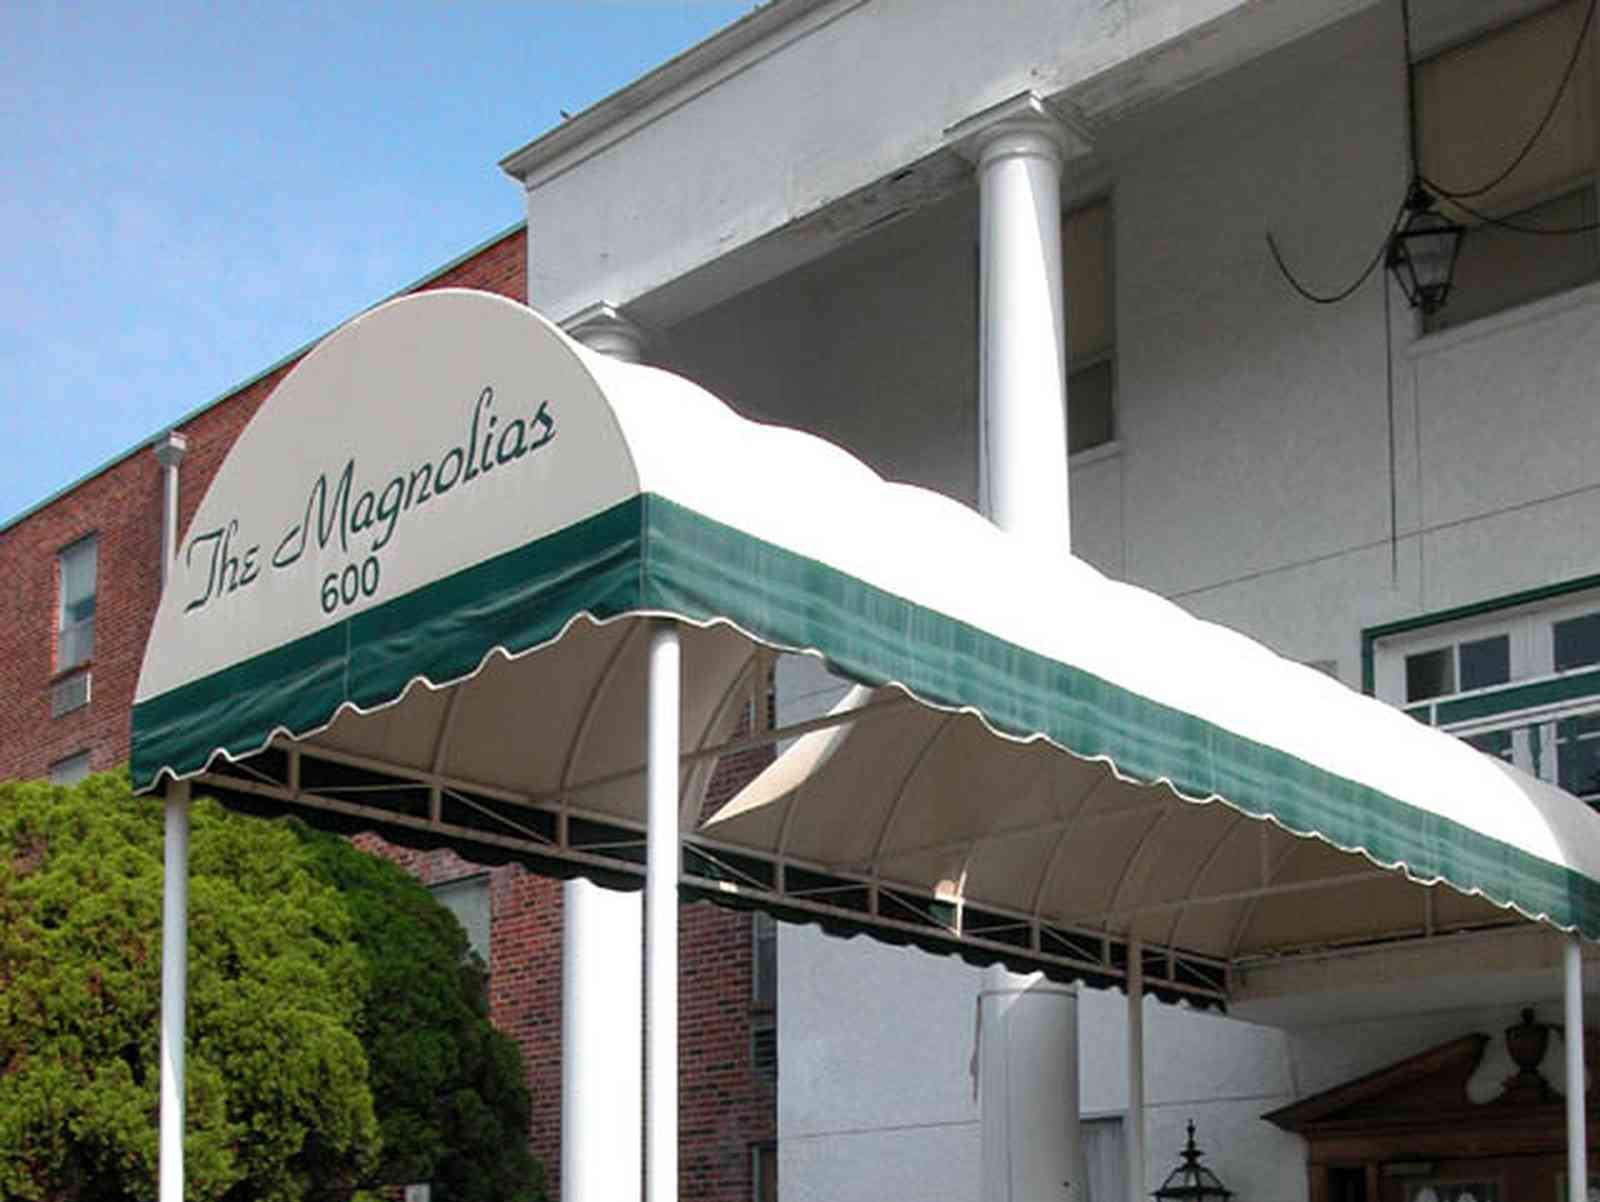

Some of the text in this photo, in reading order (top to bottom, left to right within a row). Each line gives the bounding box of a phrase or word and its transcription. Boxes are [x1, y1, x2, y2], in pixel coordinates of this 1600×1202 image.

[184, 386, 556, 614] The Magnolias
[321, 556, 380, 613] 600
